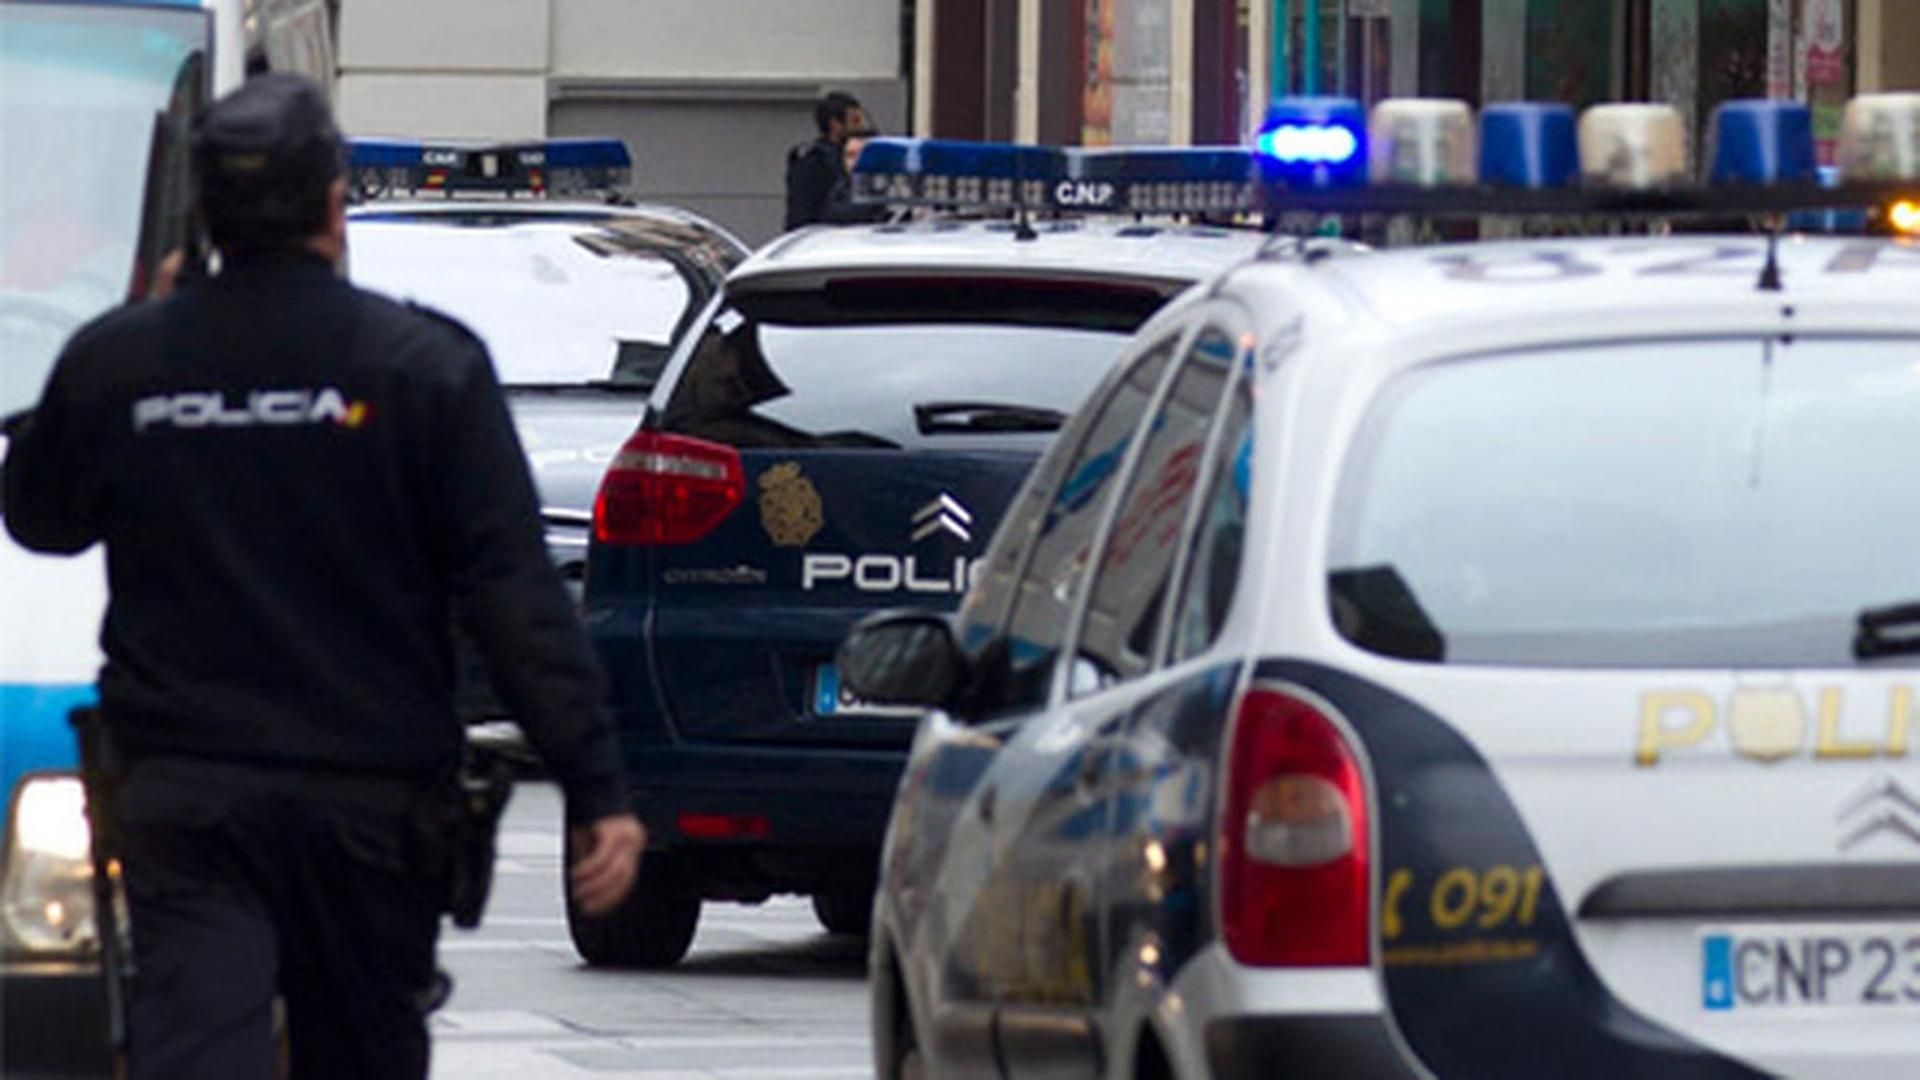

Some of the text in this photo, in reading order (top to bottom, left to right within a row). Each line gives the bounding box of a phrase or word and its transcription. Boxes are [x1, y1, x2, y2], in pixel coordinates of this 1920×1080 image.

[133, 388, 347, 434] POLICIA
[1430, 864, 1542, 929] 091
[1735, 937, 1851, 1005] CNP
